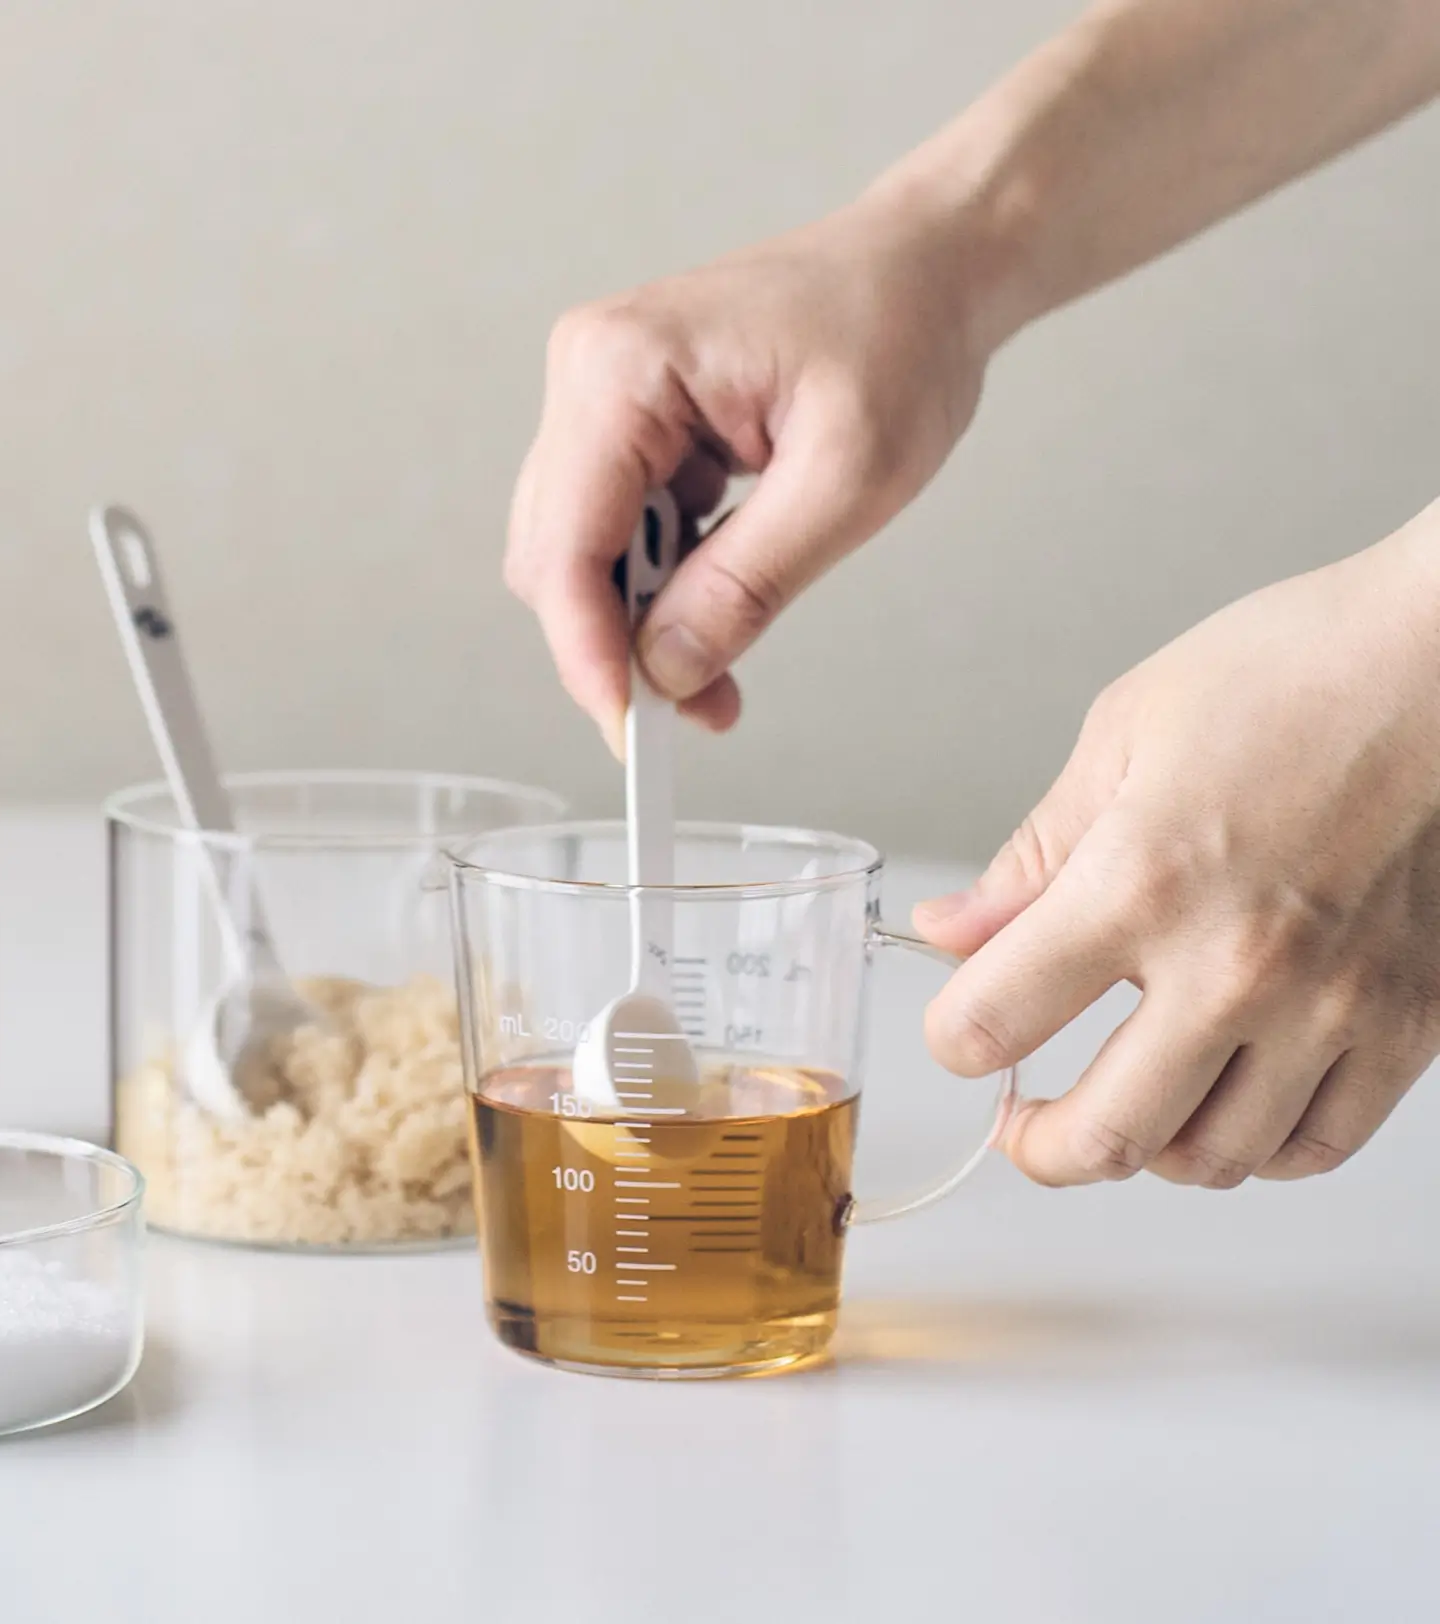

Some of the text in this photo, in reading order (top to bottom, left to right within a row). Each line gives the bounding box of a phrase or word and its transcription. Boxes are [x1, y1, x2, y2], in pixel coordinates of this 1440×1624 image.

[499, 1013, 532, 1038] mL
[548, 1091, 592, 1119] 150
[551, 1165, 595, 1193] 100
[566, 1249, 597, 1275] 50
